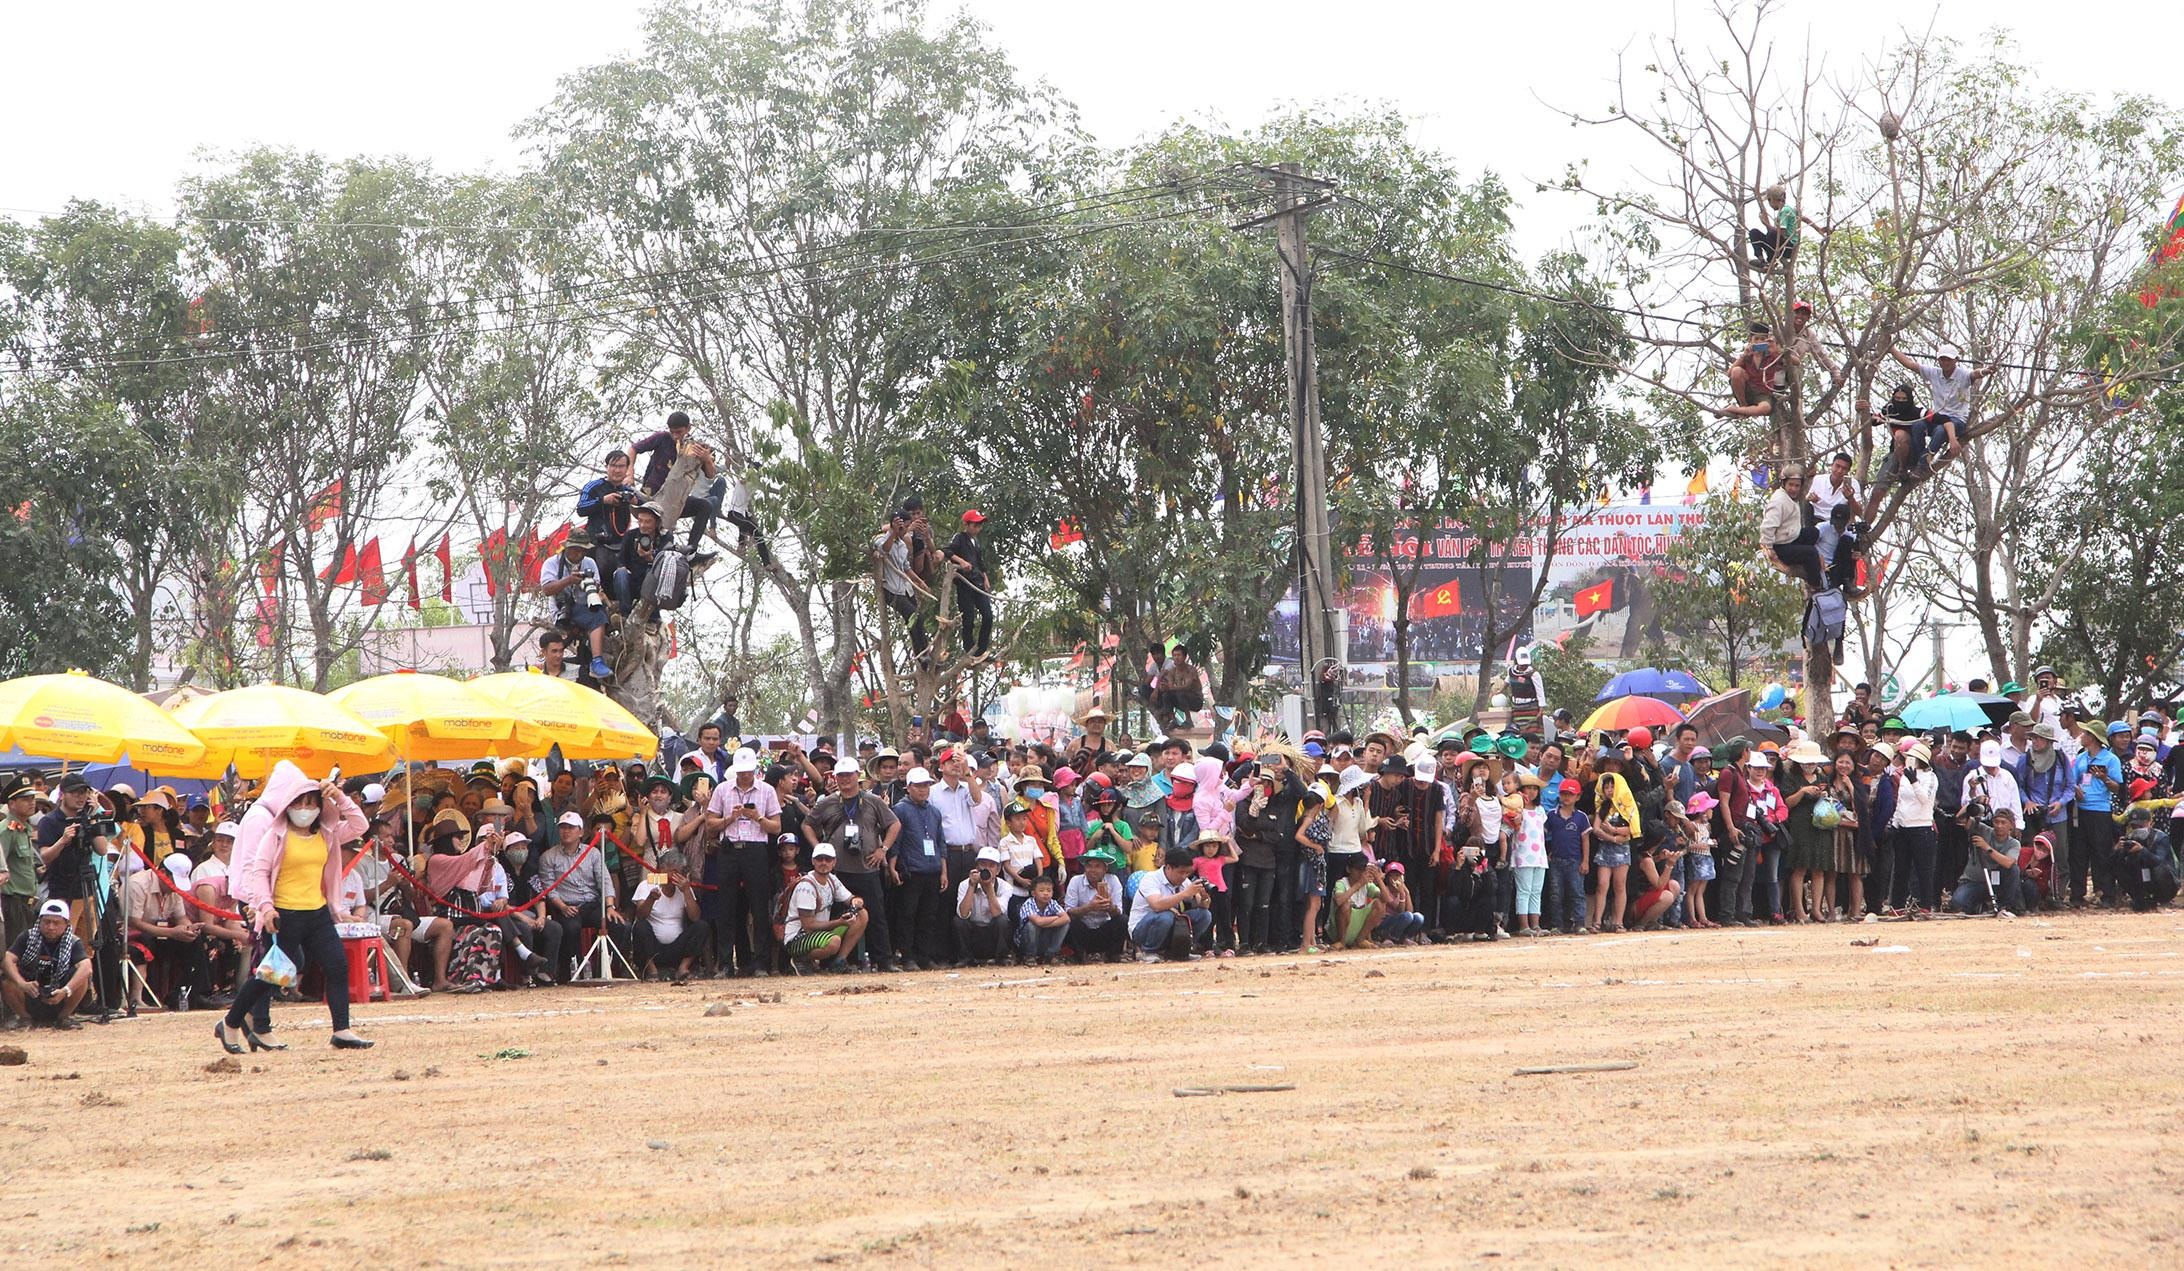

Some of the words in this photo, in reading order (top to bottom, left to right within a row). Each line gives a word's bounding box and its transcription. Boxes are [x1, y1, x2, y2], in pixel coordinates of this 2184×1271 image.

[1436, 534, 1461, 558] VĂN
[1577, 533, 1600, 556] CÁC
[1604, 532, 1628, 555] DÂN
[1631, 532, 1652, 559] TỘC
[444, 718, 492, 729] mobifone
[320, 730, 366, 743] mobifone
[142, 743, 185, 755] mobifone
